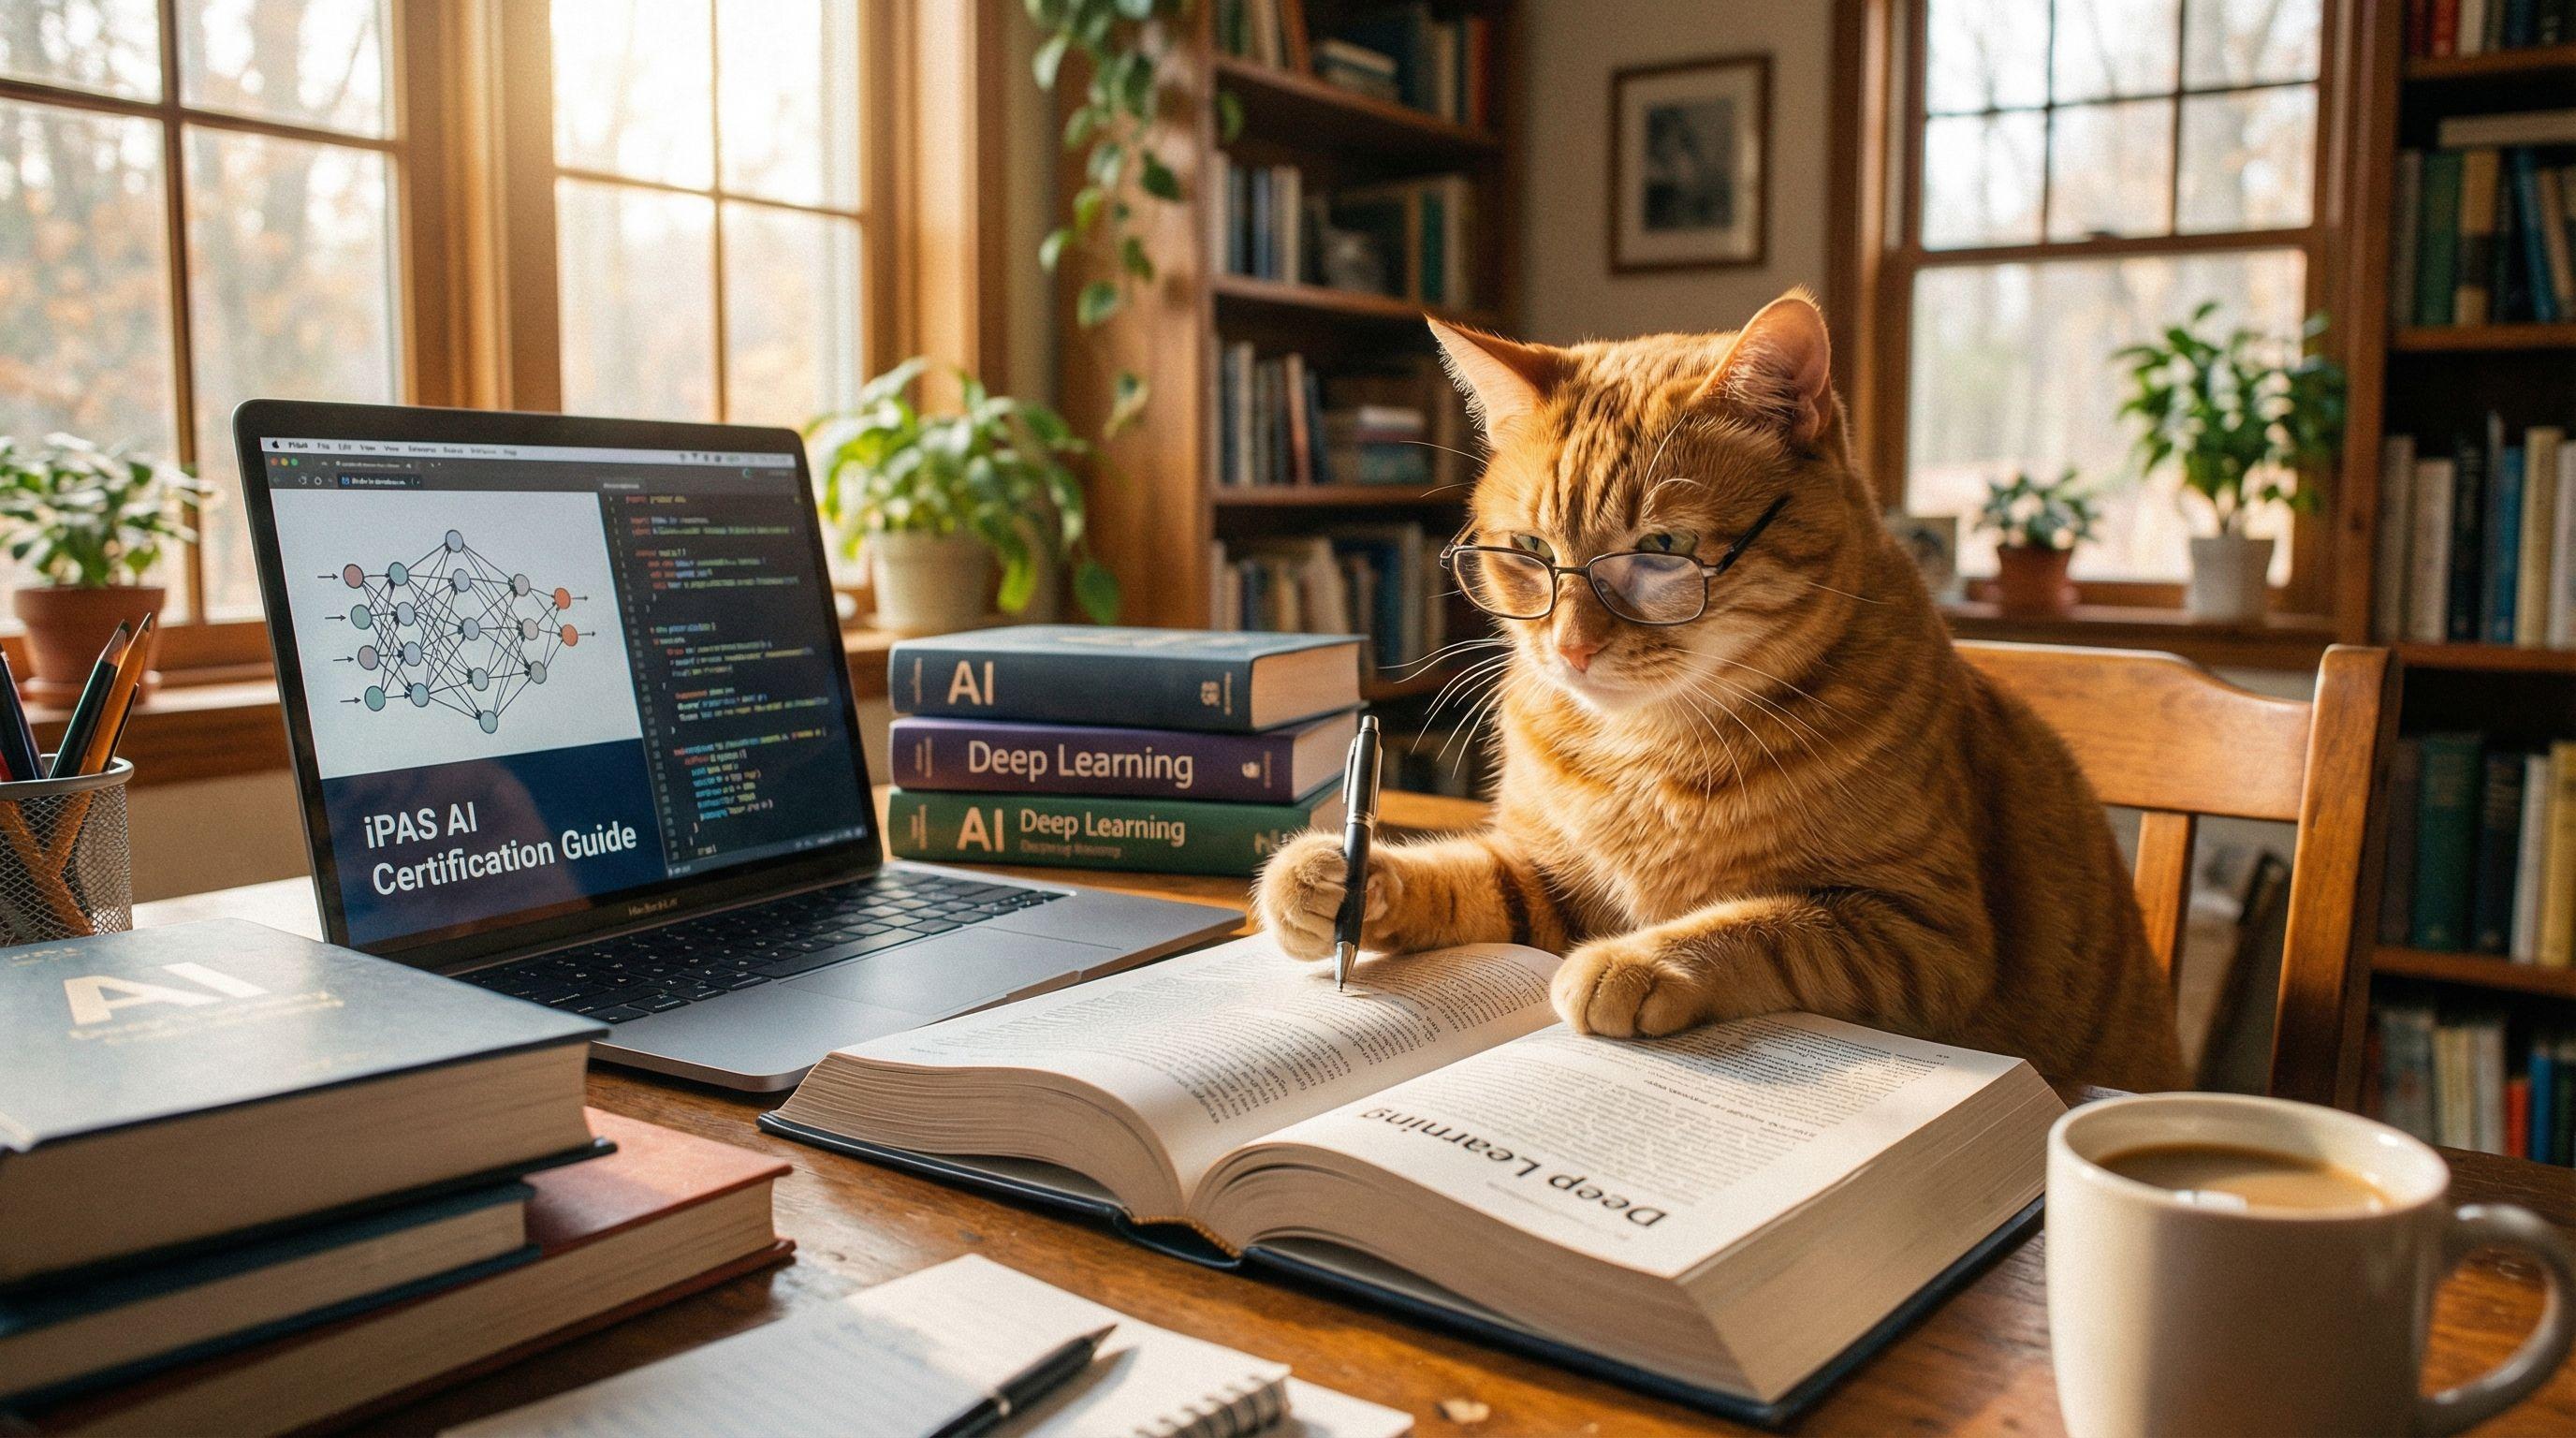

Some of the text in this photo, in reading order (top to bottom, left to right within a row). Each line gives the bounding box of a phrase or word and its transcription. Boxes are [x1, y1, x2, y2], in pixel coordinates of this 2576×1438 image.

[947, 660, 994, 706] AI
[968, 741, 1193, 789] Deep Learning
[364, 801, 477, 849] iPAS AI
[957, 807, 1004, 853] AI
[1019, 808, 1079, 842] Deep
[1084, 811, 1186, 848] Learning
[373, 820, 637, 895] Certification Guide
[63, 961, 270, 1026] AI
[1358, 1107, 1542, 1178] Learning
[1548, 1173, 1667, 1227] Deep
